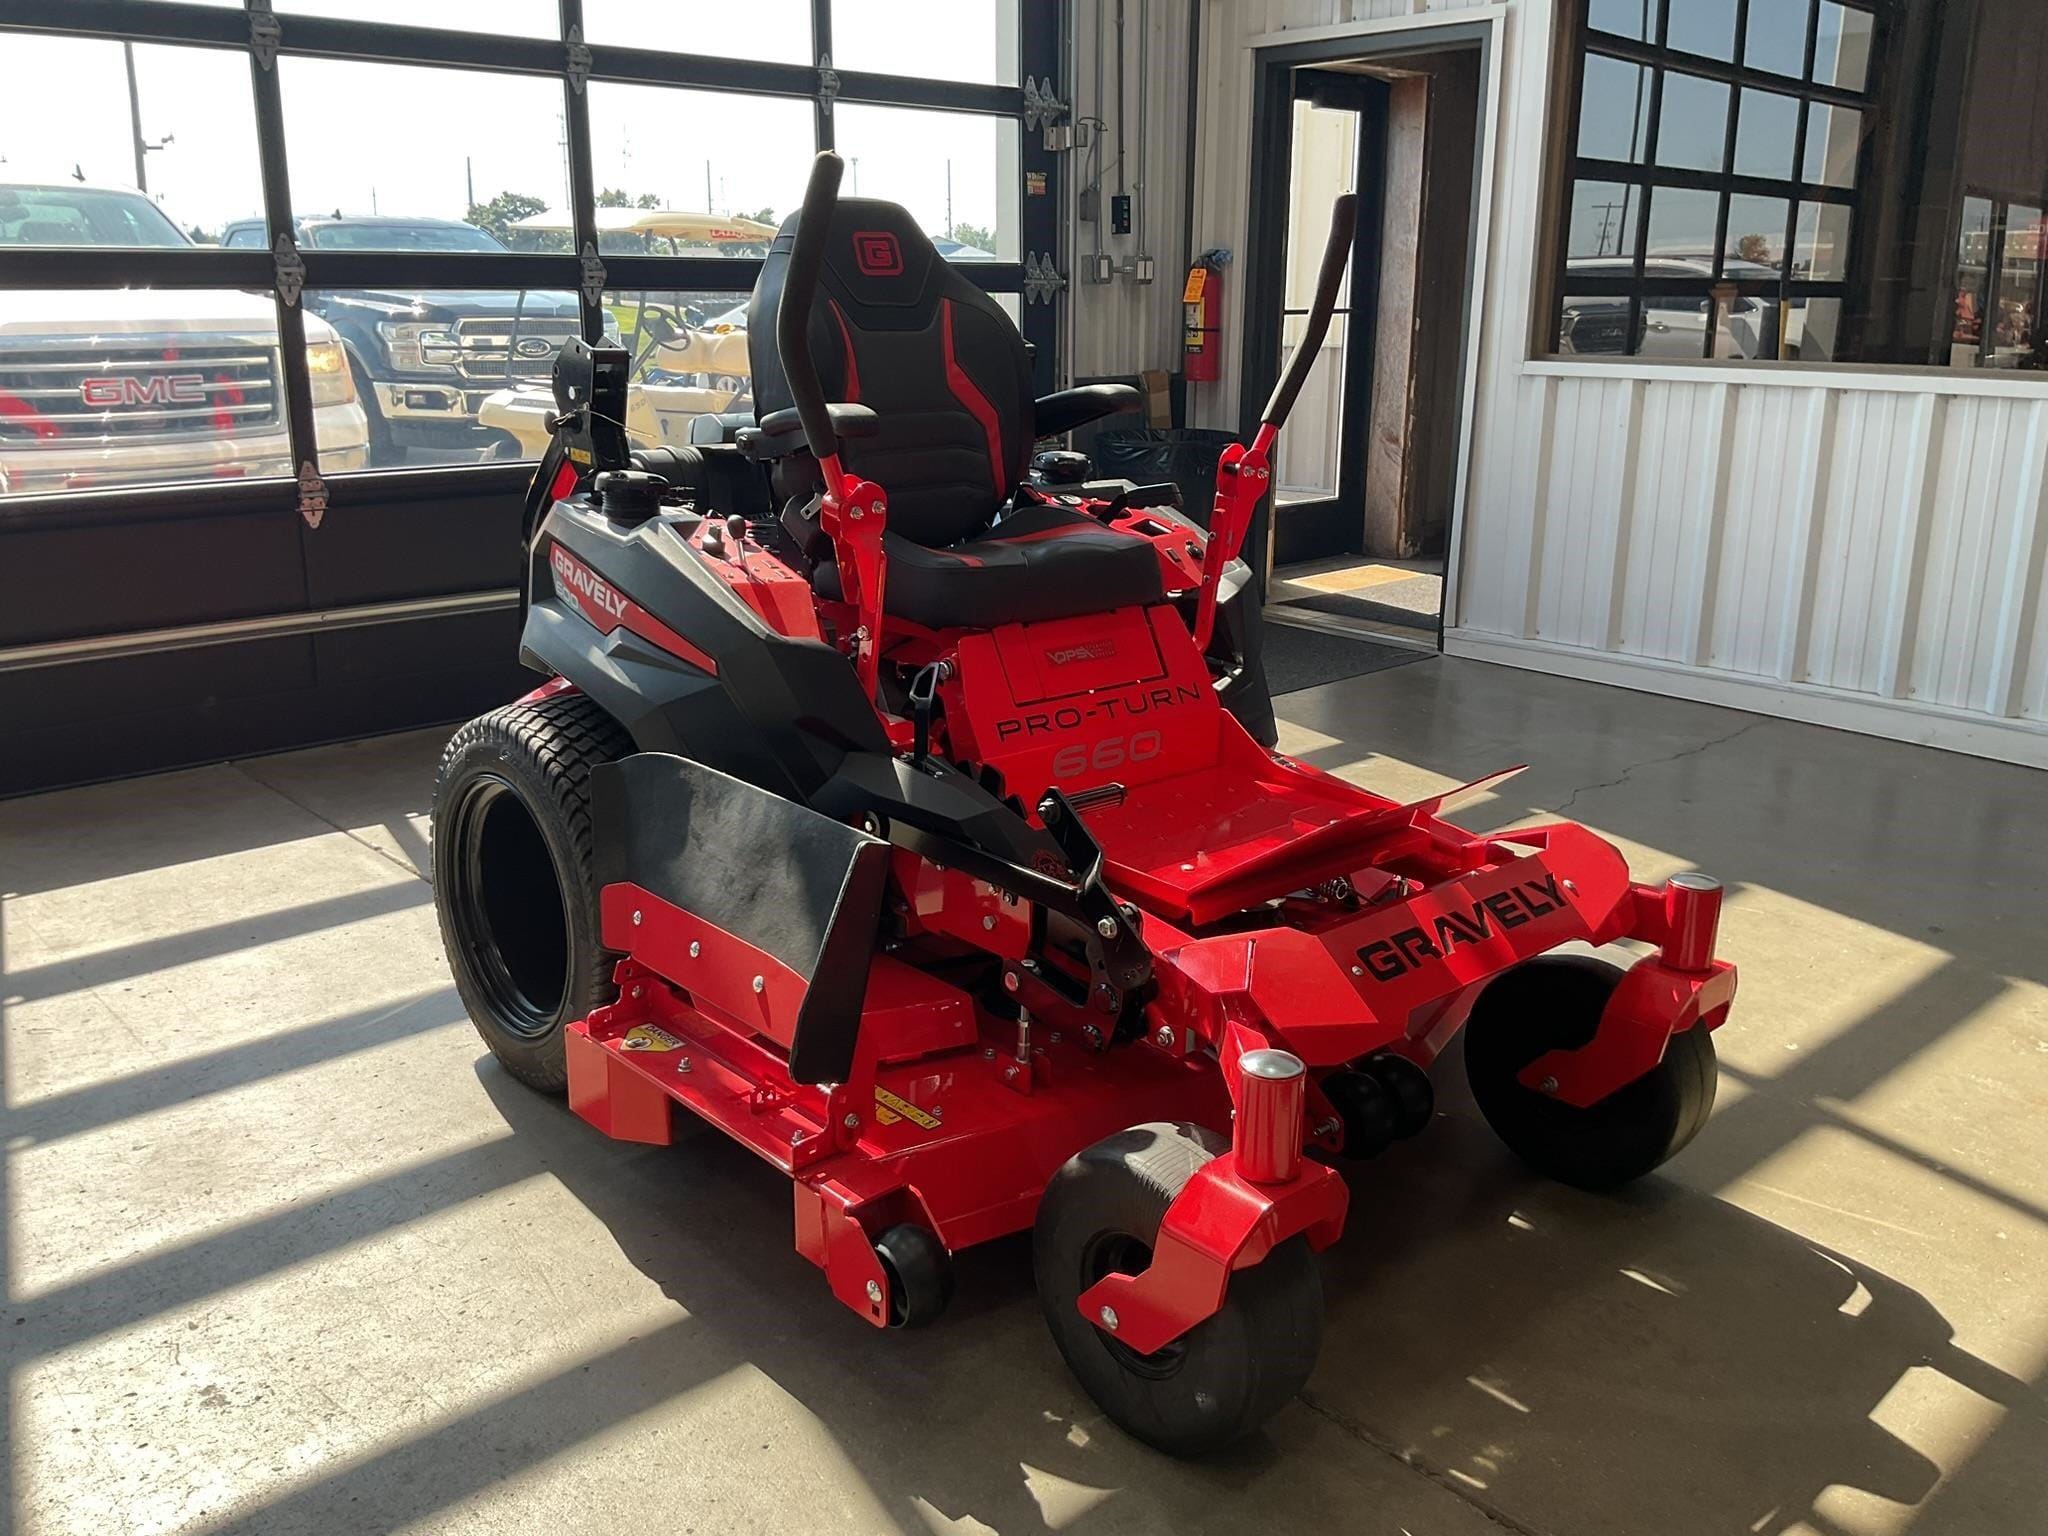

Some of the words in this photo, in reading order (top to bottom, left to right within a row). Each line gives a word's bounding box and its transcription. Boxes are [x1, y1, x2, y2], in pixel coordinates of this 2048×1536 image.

[81, 374, 206, 406] GMC
[555, 549, 628, 619] GRAVELY
[996, 682, 1200, 742] PRO-TURN
[1053, 730, 1162, 778] 660
[1356, 873, 1566, 981] GRAVELY
